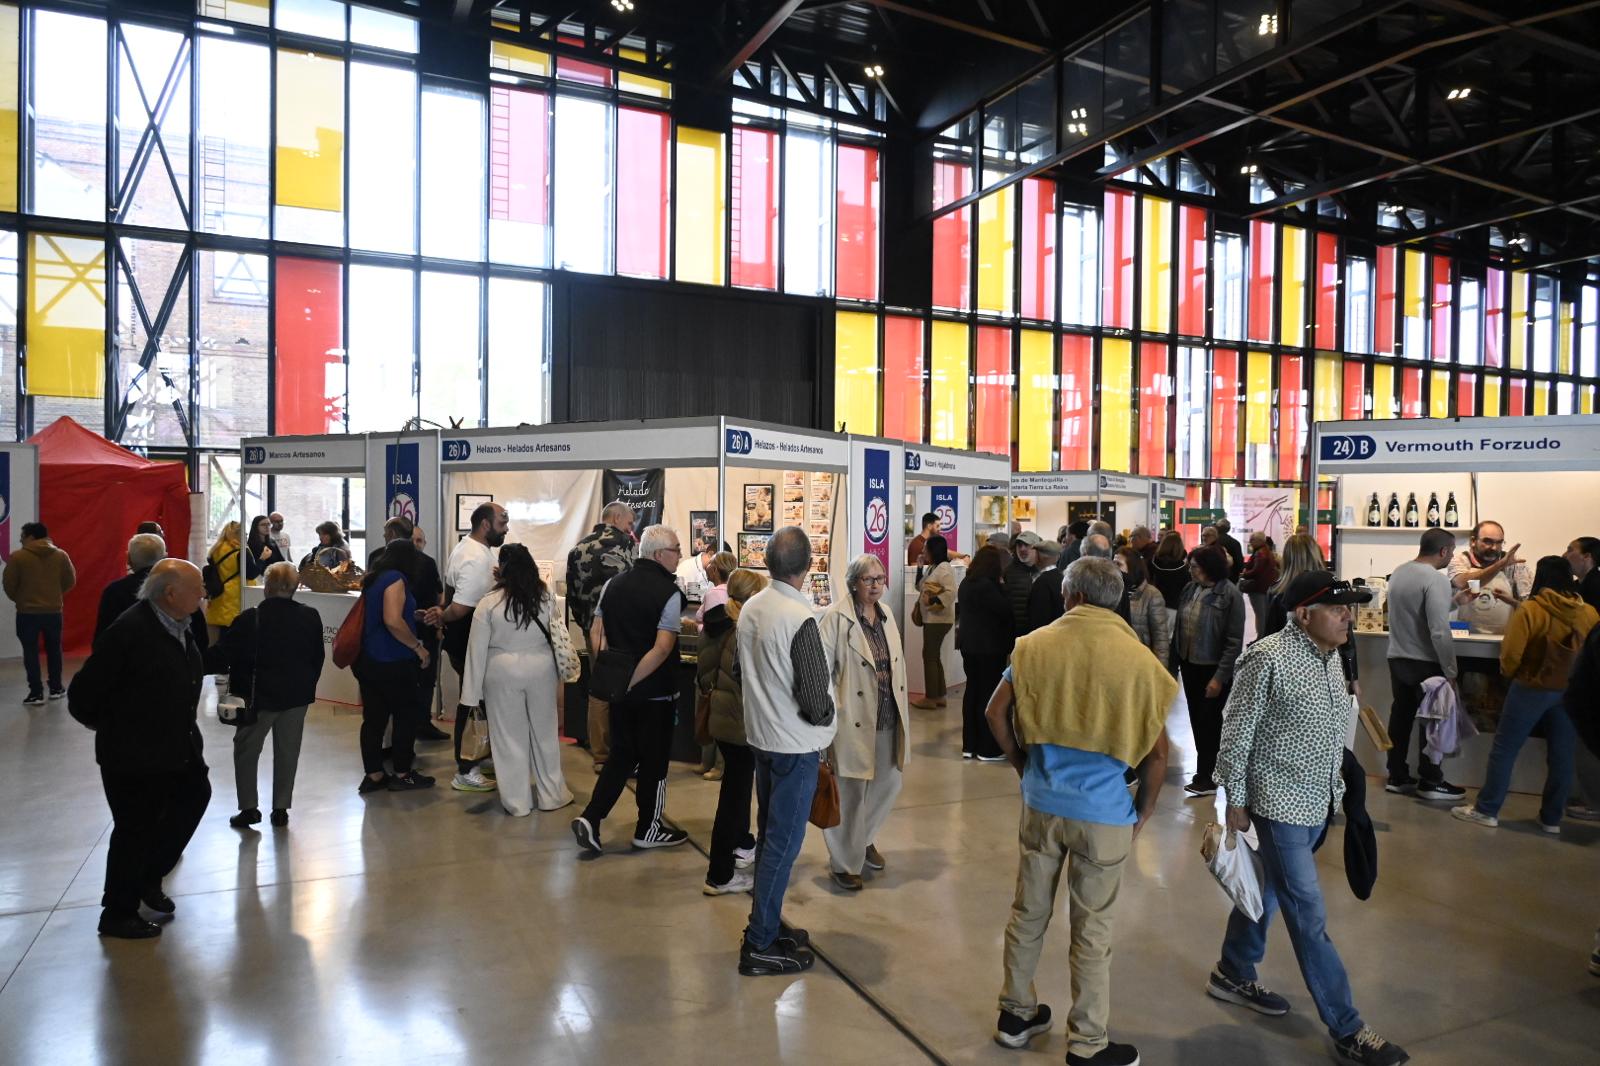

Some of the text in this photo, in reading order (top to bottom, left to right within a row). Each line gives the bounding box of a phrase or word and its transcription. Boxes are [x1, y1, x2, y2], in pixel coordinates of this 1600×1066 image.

[448, 444, 458, 457] 26
[462, 445, 467, 456] A
[476, 445, 502, 454] Helazos
[507, 444, 534, 453] Helados
[536, 443, 571, 452] Artesanos
[732, 434, 741, 450] 26
[744, 436, 749, 450] A
[754, 439, 776, 450] Helazos
[780, 442, 800, 452] Helados
[800, 444, 824, 454] Artesanos
[1333, 437, 1561, 456] 24 B Vermouth Forzudo
[392, 473, 412, 485] ISLA
[869, 478, 885, 489] ISLA
[869, 504, 885, 532] 26
[937, 508, 952, 525] 25
